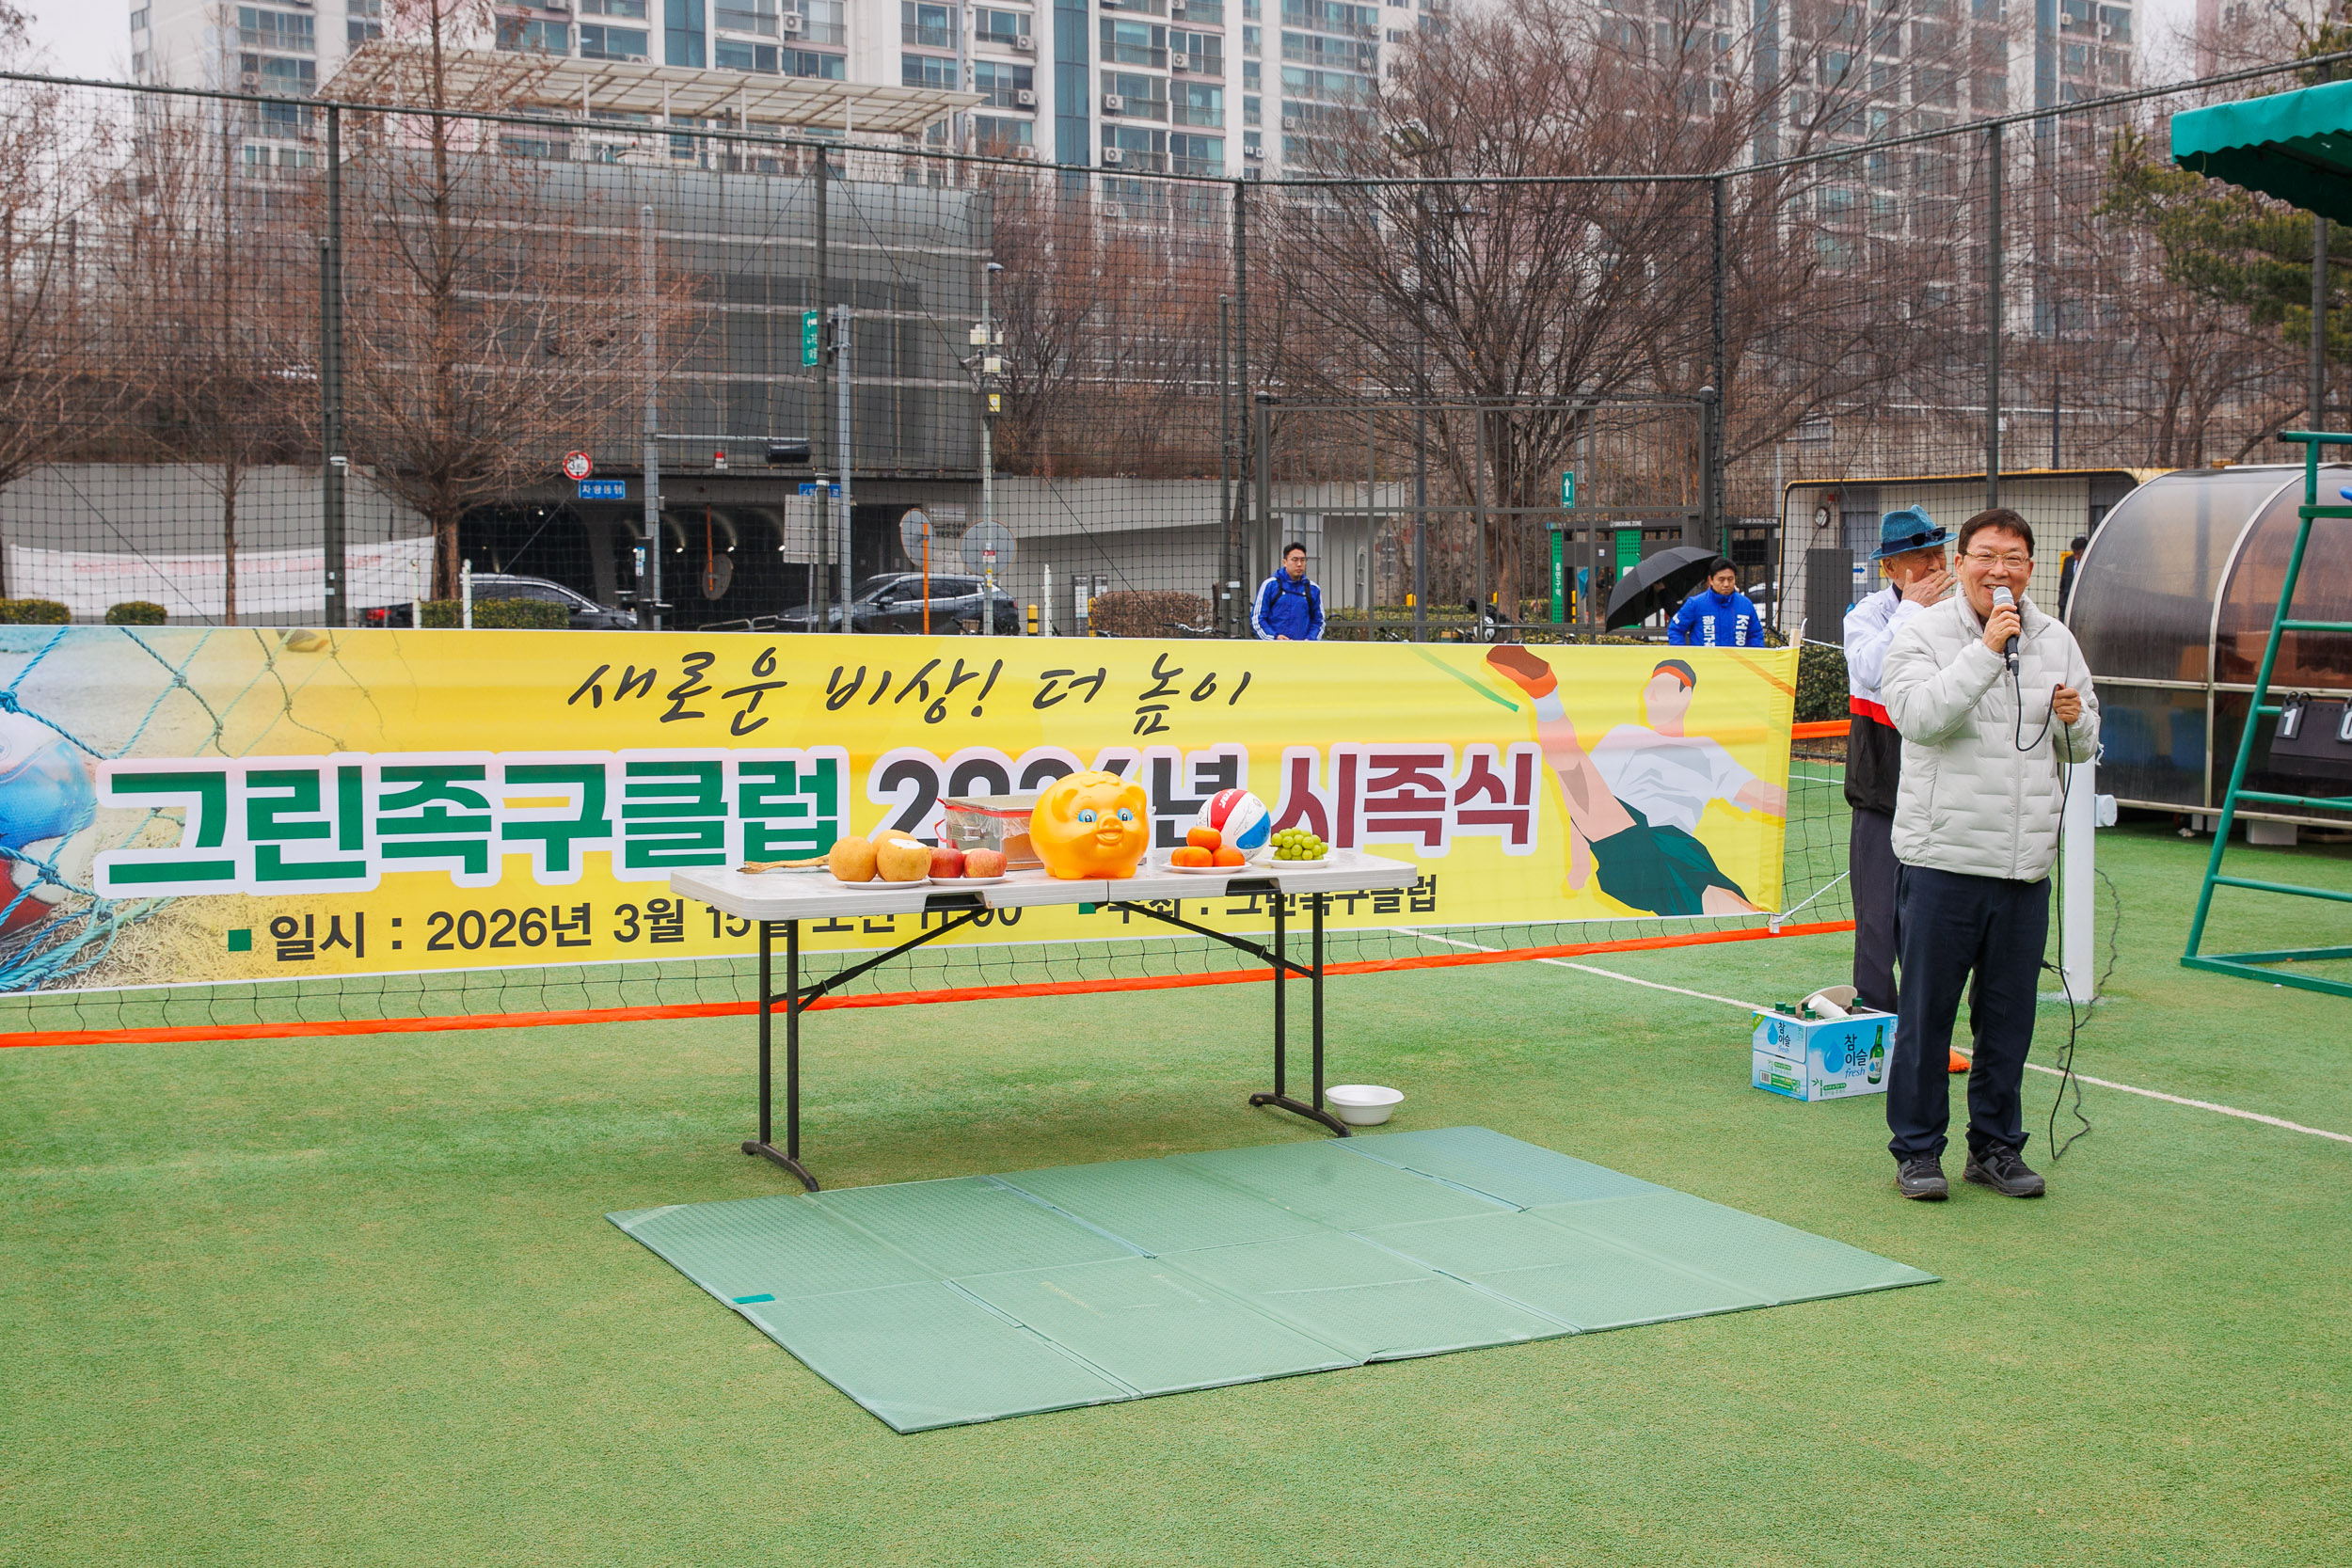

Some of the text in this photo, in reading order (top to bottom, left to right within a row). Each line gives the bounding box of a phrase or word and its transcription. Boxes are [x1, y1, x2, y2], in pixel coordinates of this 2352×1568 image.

[568, 647, 1251, 736] 새로운 비상! 더 높이
[2283, 707, 2297, 736] 1
[108, 758, 837, 885] 그린족구클럽
[1270, 753, 1533, 847] 시족식
[269, 911, 365, 961] 일시
[391, 917, 403, 950] :
[426, 902, 592, 951] 2026년
[613, 898, 685, 943] 3월
[1844, 1034, 1857, 1052] 참
[1845, 1049, 1867, 1068] 이슬
[1845, 1067, 1866, 1079] fresh
